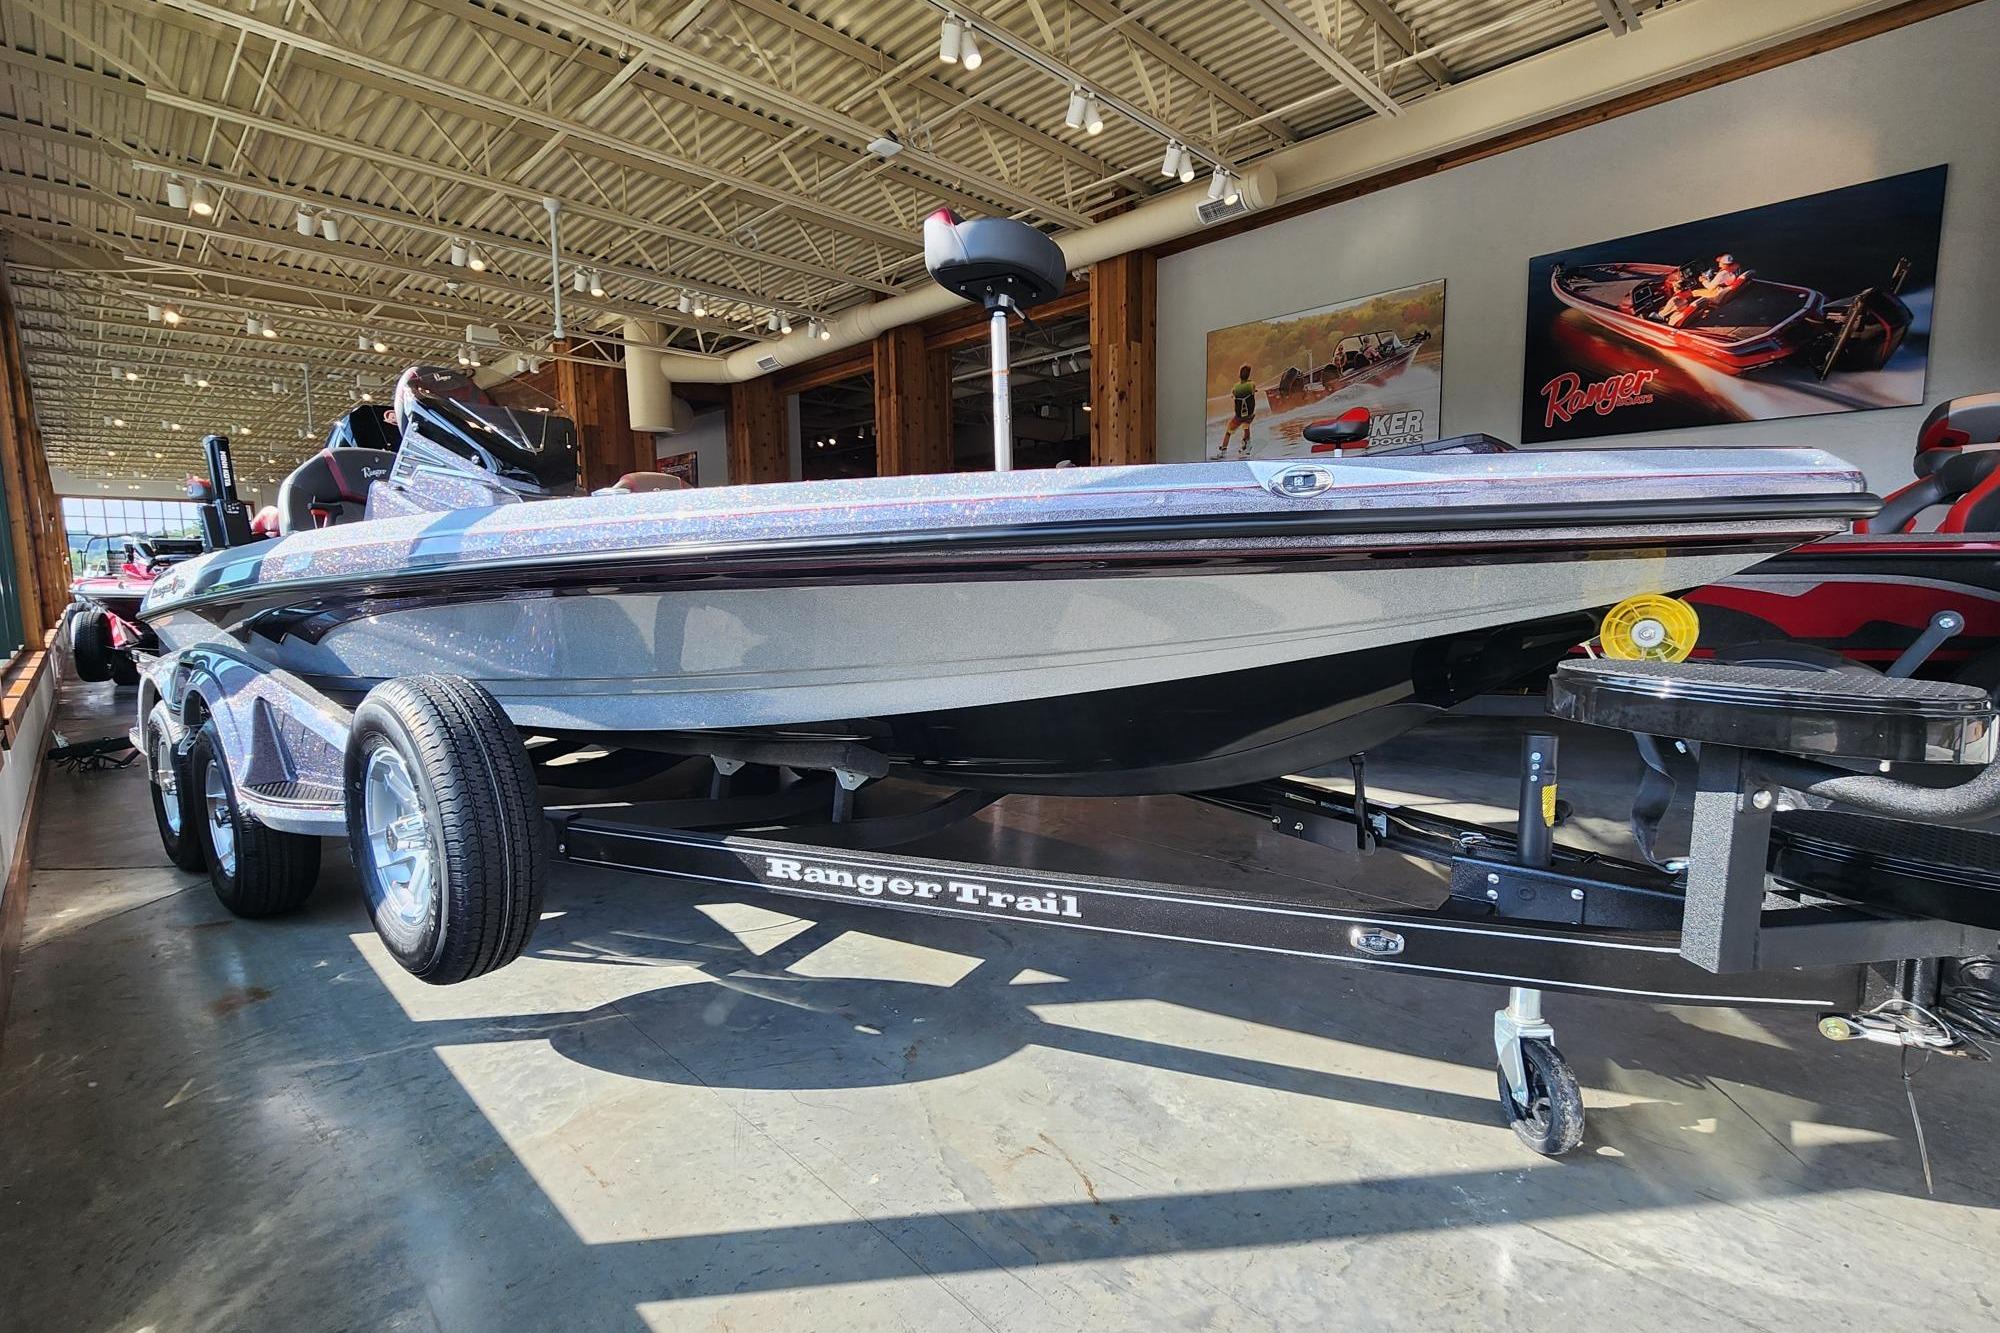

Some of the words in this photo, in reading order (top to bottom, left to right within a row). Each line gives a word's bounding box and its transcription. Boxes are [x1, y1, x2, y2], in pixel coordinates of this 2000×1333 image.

[1541, 370, 1654, 428] Ranger
[1368, 410, 1424, 437] KER
[1368, 434, 1423, 447] boats
[361, 466, 387, 478] Ranger
[765, 857, 943, 899] Ranger
[948, 880, 1083, 918] Trail
